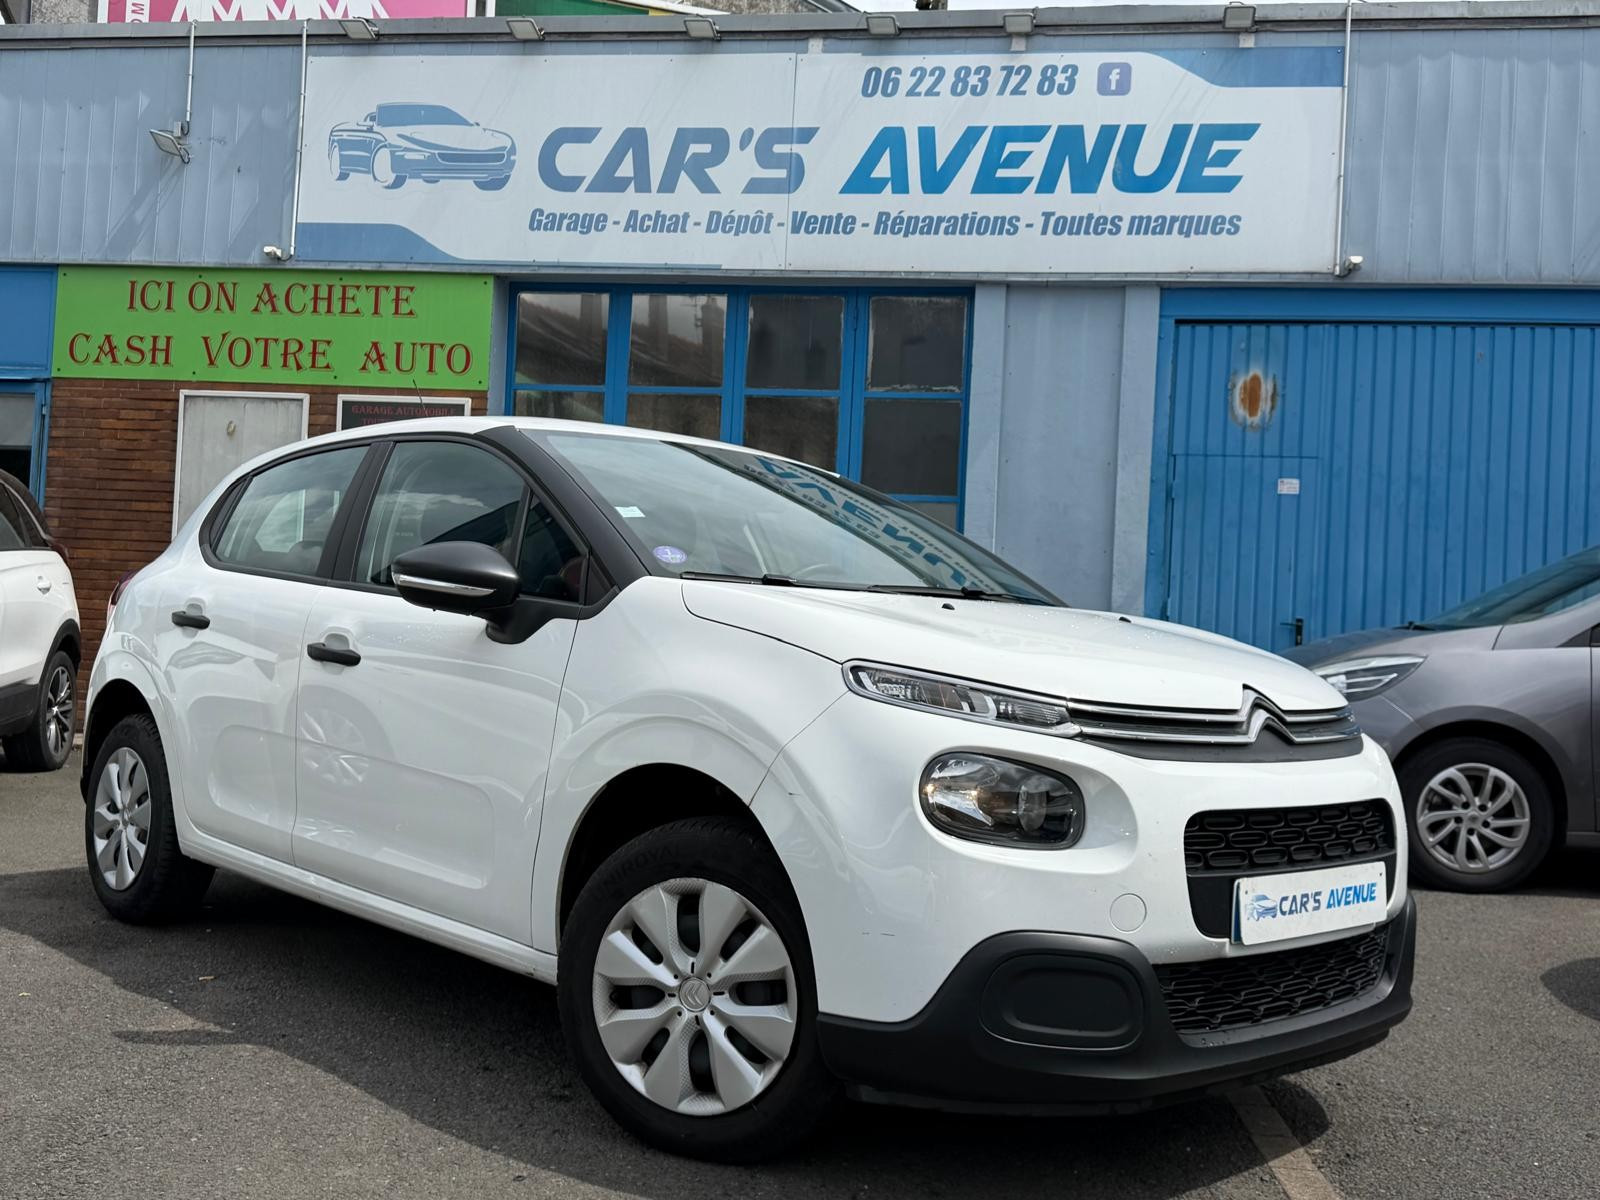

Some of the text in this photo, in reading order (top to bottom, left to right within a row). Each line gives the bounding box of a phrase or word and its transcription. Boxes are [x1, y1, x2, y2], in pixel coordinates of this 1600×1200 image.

[861, 64, 1079, 98] 06 22 83 72 83
[538, 123, 1261, 195] CAR'S AVENUE
[528, 208, 608, 235] Garage
[623, 209, 690, 234] Achat
[705, 210, 774, 237] Dépôt
[790, 211, 857, 236] Vente
[873, 210, 1021, 238] Réparations
[1040, 211, 1123, 237] Toutes
[1126, 214, 1242, 239] marques
[127, 279, 416, 318] ICI ON ACHETE
[67, 331, 473, 375] CASH VOTRE AUTO
[351, 404, 394, 416] GARAGE
[1279, 882, 1377, 916] CAR'S AVENUE
